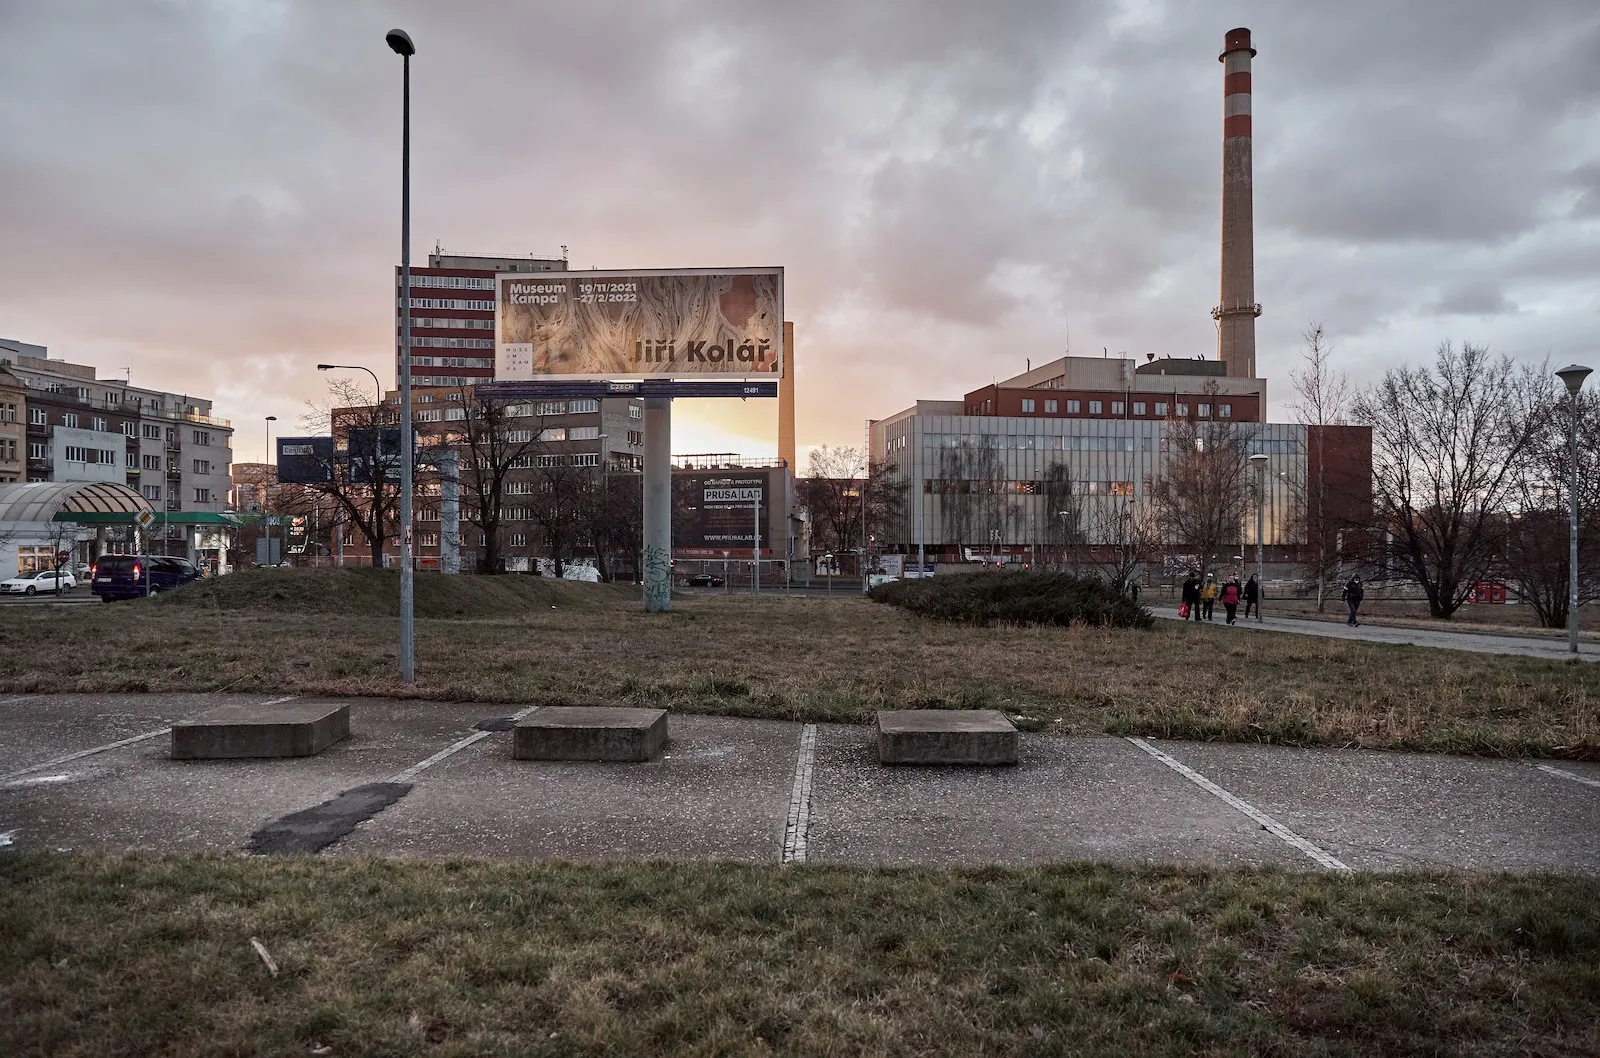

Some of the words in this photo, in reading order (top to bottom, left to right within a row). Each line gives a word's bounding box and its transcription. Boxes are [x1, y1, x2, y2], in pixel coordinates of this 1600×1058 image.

[510, 284, 566, 293] Museum
[579, 283, 637, 294] 19/11/2021
[510, 294, 558, 306] Kampa
[635, 339, 676, 363] Jiří
[687, 338, 770, 363] Kolář
[706, 490, 738, 499] PRUSA
